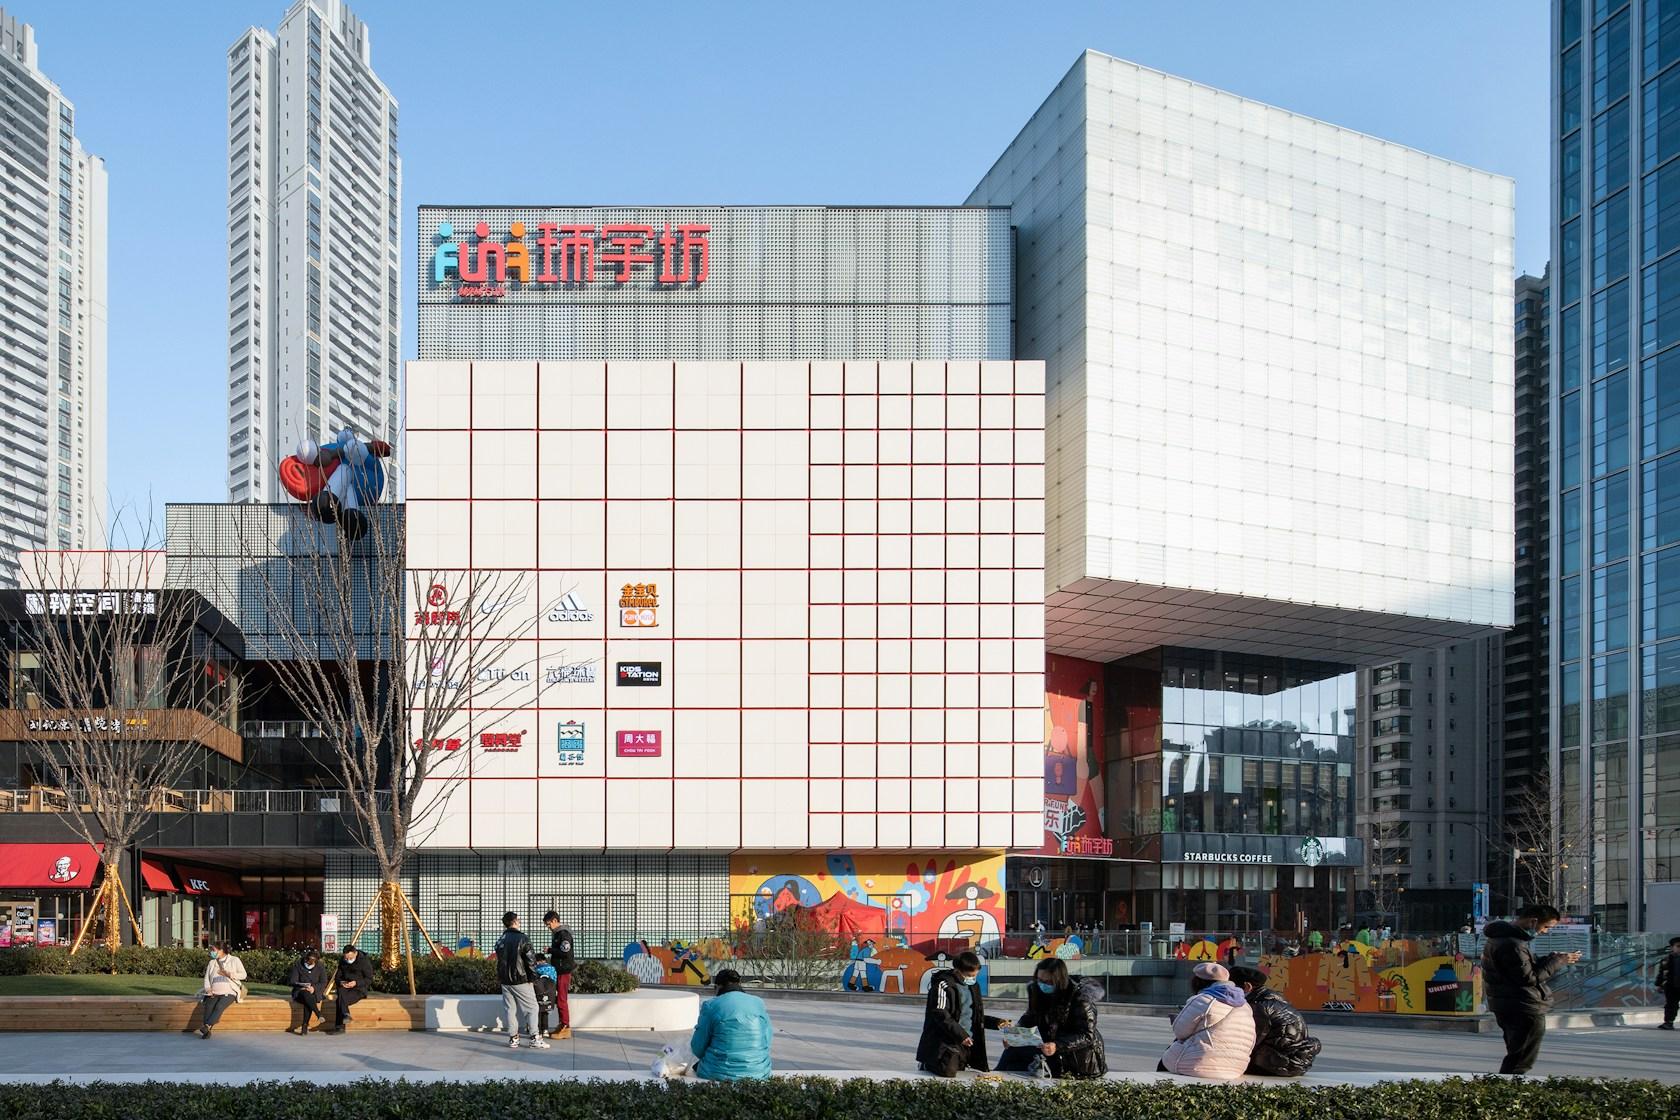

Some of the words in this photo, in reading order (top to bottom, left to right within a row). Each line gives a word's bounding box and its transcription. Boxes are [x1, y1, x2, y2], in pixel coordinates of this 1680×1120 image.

[621, 582, 658, 597] 金宝贝
[549, 610, 593, 622] adidas
[624, 733, 656, 744] 周大福
[1184, 852, 1238, 862] STARBUCKS
[1239, 854, 1272, 863] COFFEE
[190, 878, 210, 891] KFC
[209, 906, 215, 919] 3
[1428, 983, 1459, 993] UNIFUN
